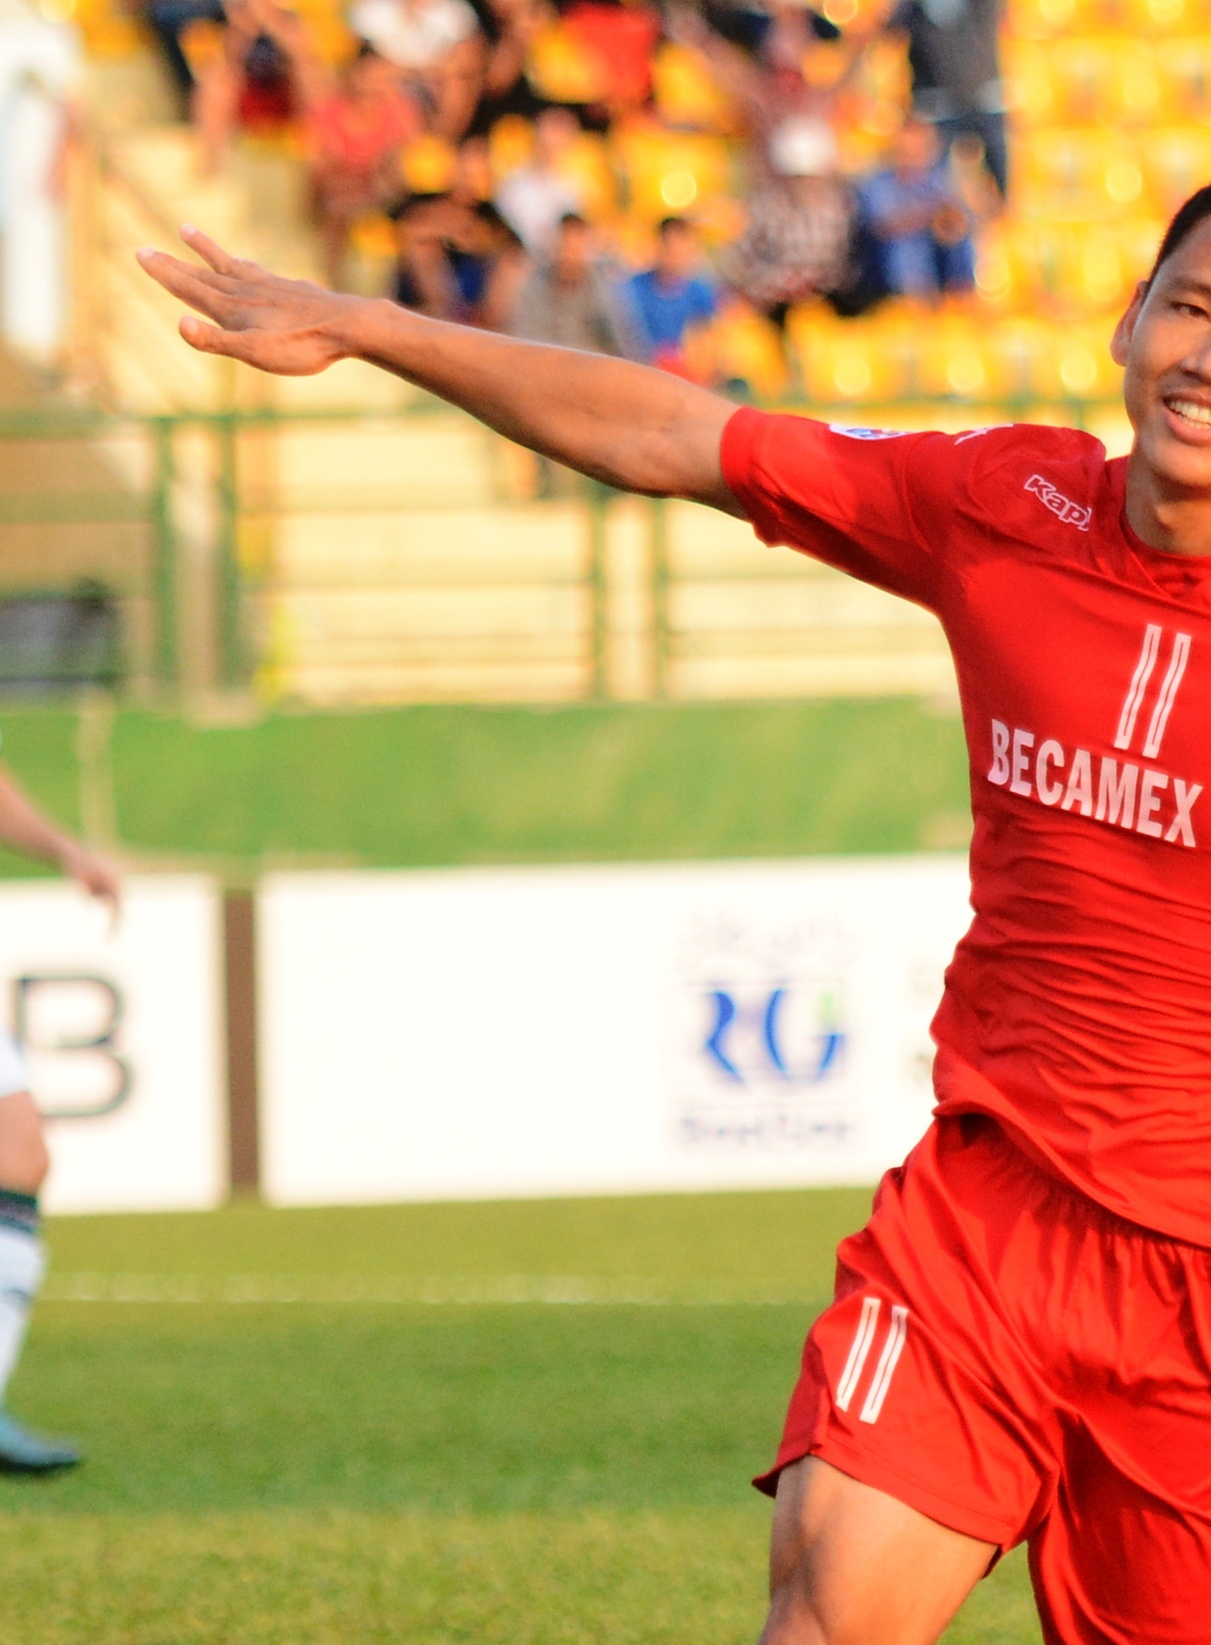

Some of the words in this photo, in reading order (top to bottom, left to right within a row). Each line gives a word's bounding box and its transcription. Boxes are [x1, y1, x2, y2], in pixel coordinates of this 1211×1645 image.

[1113, 623, 1192, 759] 11
[988, 719, 1203, 848] BECAMEX
[836, 1296, 909, 1425] 11
